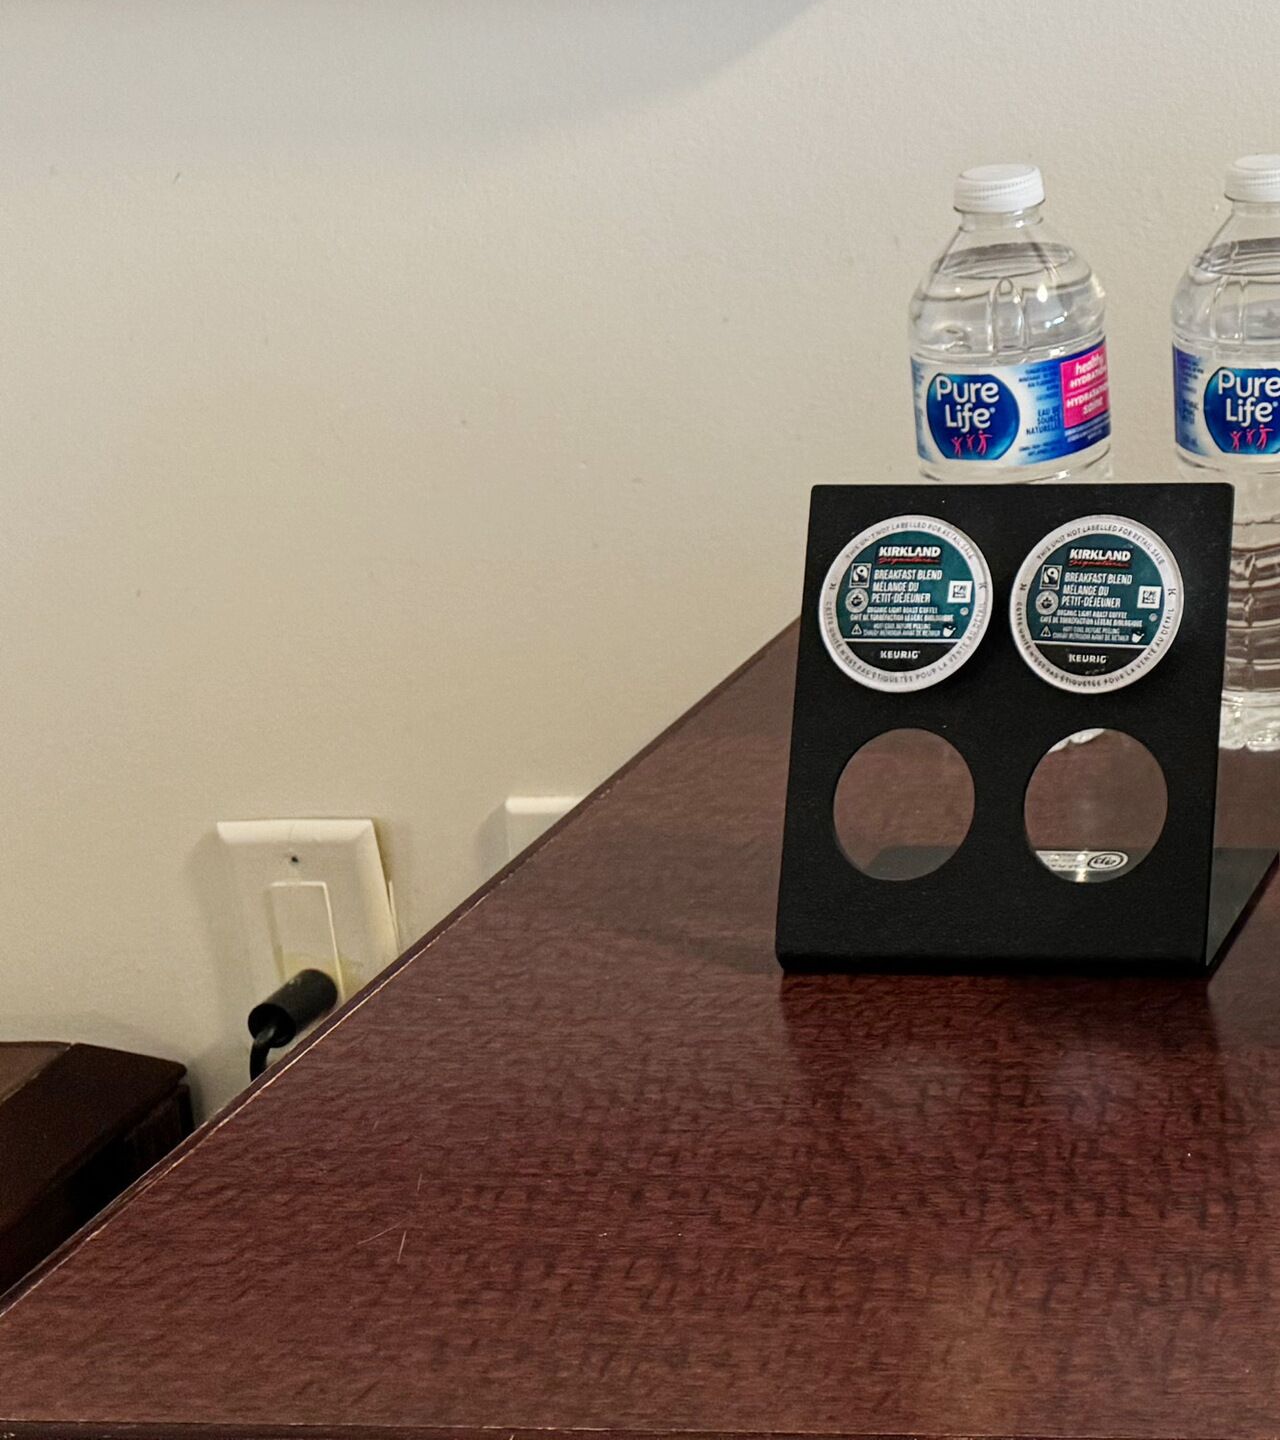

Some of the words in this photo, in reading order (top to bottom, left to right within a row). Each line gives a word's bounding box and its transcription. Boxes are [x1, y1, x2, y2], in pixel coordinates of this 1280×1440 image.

[935, 375, 1000, 404] Pure
[945, 403, 991, 433] Life
[1226, 397, 1273, 427] Life
[879, 546, 941, 558] KIRKLAND
[1069, 548, 1132, 561] KIRKLAND
[874, 569, 917, 581] BREAKFAST
[917, 570, 943, 581] BLEND
[1064, 572, 1107, 584] BREAKFAST
[1107, 574, 1133, 585] BLEND
[872, 580, 907, 592] MÉLANGE
[908, 582, 919, 592] DU
[1062, 584, 1097, 596] MÉLANGE
[1098, 586, 1110, 596] DU
[1061, 596, 1121, 608] PETIT-DÉJEUNER
[880, 650, 919, 660] KEURIG
[1068, 654, 1107, 664] KEURIG
